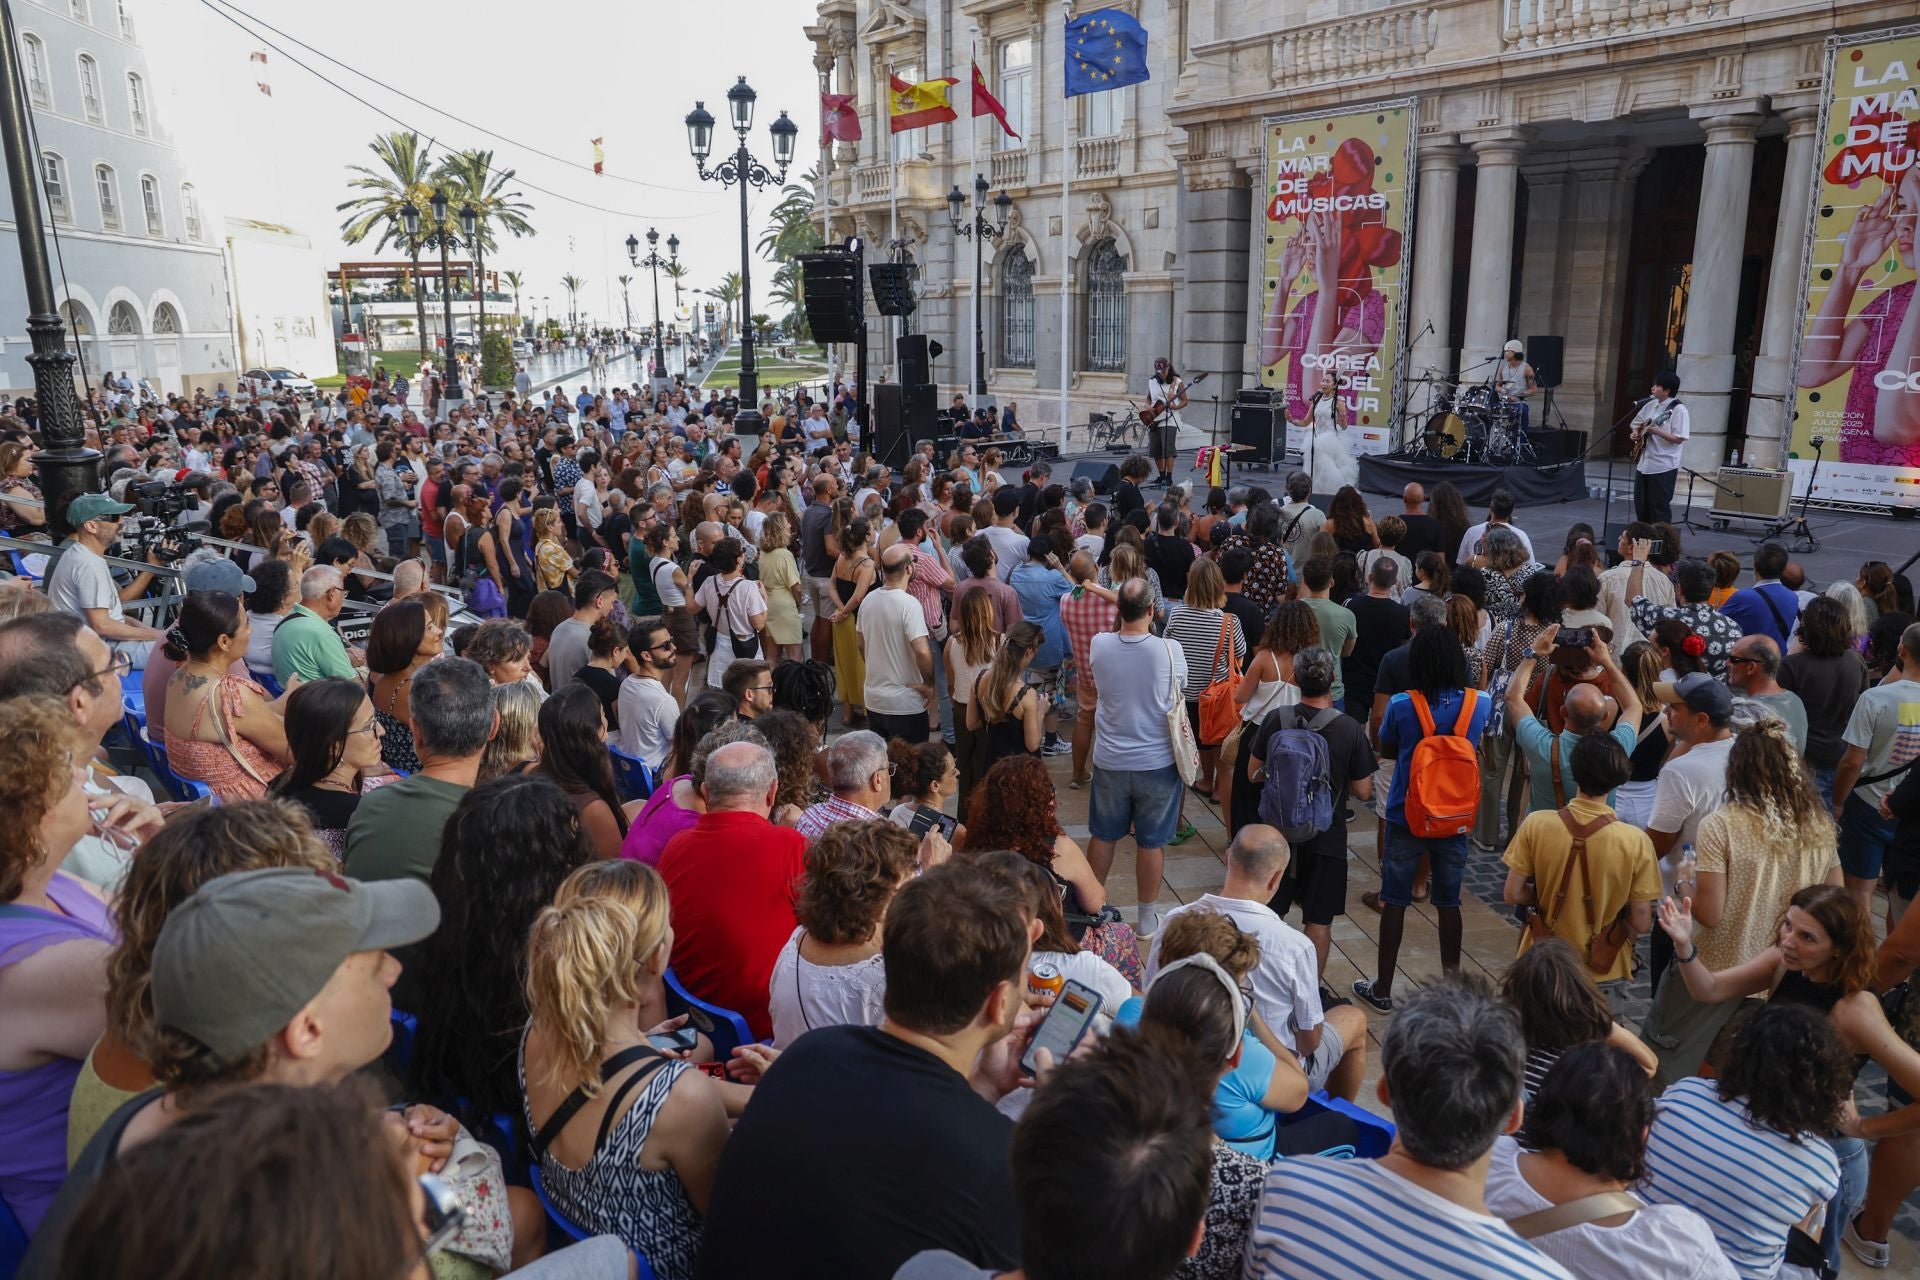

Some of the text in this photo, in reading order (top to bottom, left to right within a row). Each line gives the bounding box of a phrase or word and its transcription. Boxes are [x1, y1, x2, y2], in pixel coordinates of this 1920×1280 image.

[1854, 61, 1909, 87] LA
[1846, 120, 1909, 147] DE
[1278, 136, 1306, 154] LA
[1277, 155, 1329, 175] MAR
[1277, 178, 1308, 195] DE
[1275, 192, 1386, 216] MÚSICAS
[1300, 352, 1381, 371] COREA
[1337, 375, 1381, 392] DEL
[1337, 395, 1379, 413] UR
[1811, 418, 1864, 428] JULIO 2025
[1811, 426, 1870, 436] CARTAGENA
